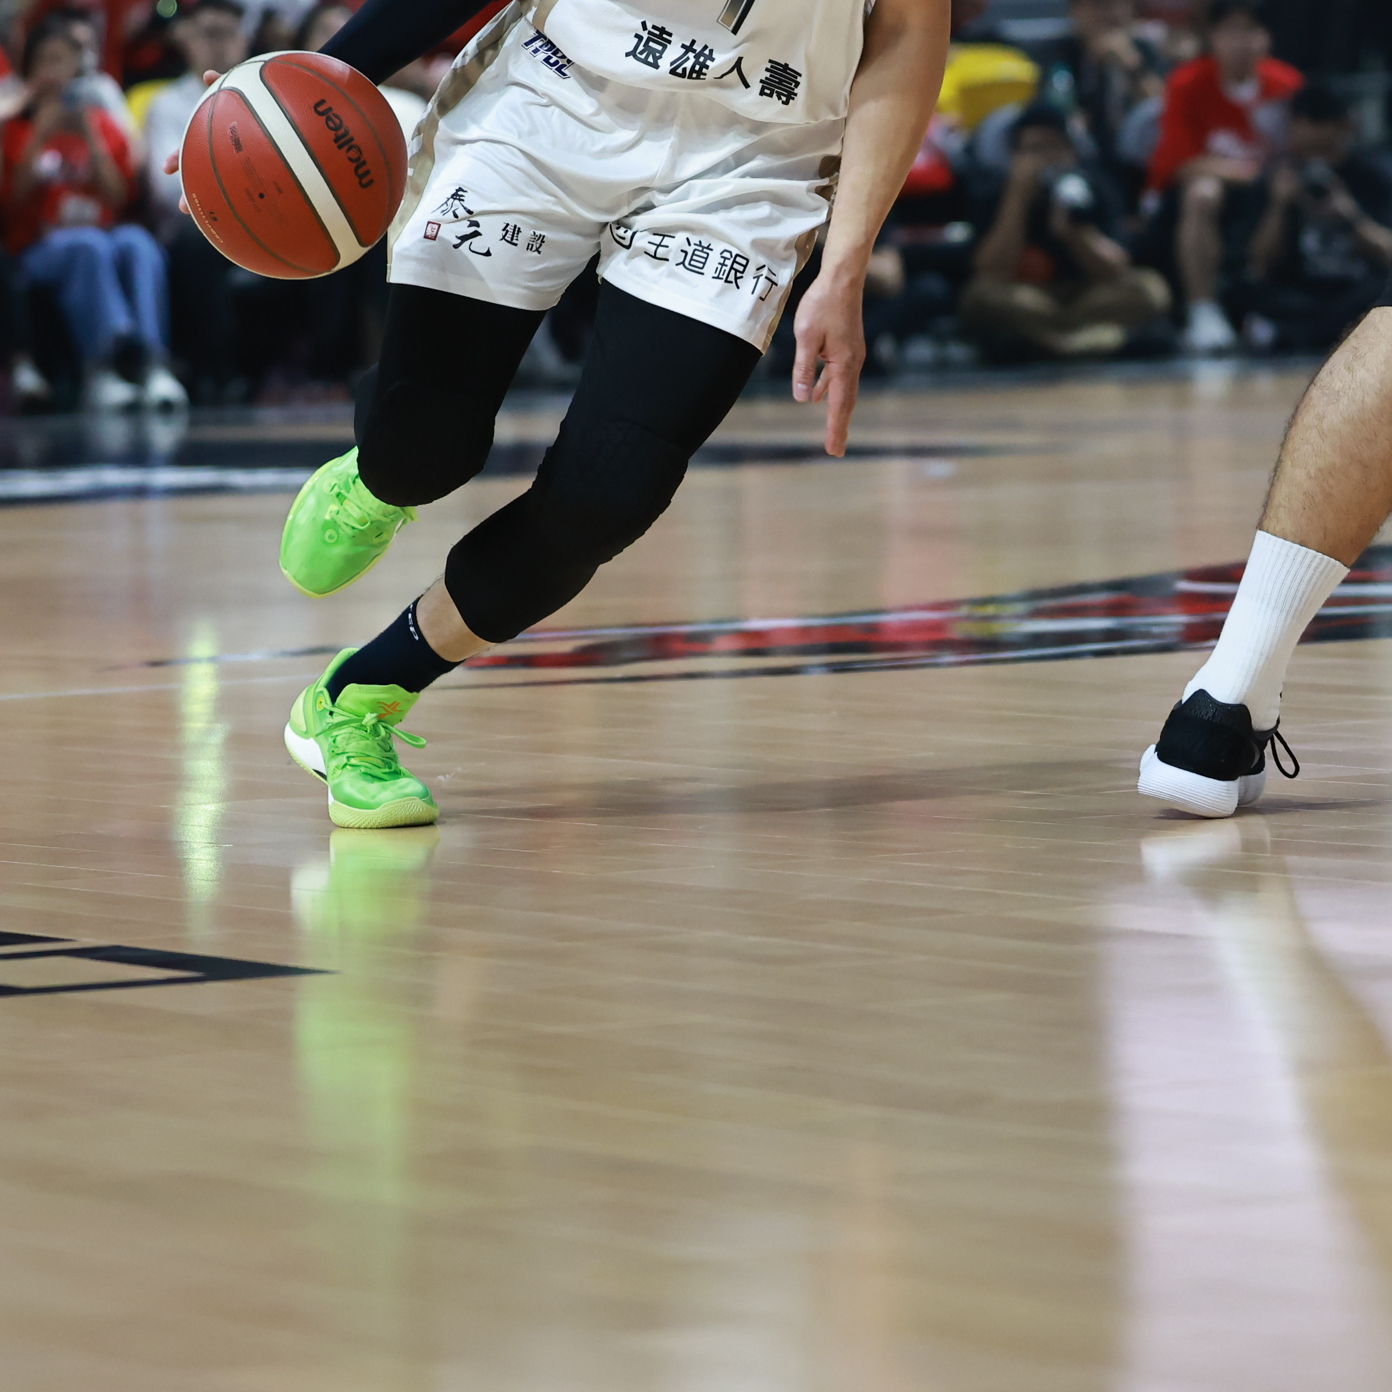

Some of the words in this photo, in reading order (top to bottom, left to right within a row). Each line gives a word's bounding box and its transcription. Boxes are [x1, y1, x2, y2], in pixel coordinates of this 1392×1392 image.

[624, 20, 803, 105] 遠雄人壽
[313, 99, 375, 189] molten
[644, 233, 778, 301] 王道銀行
